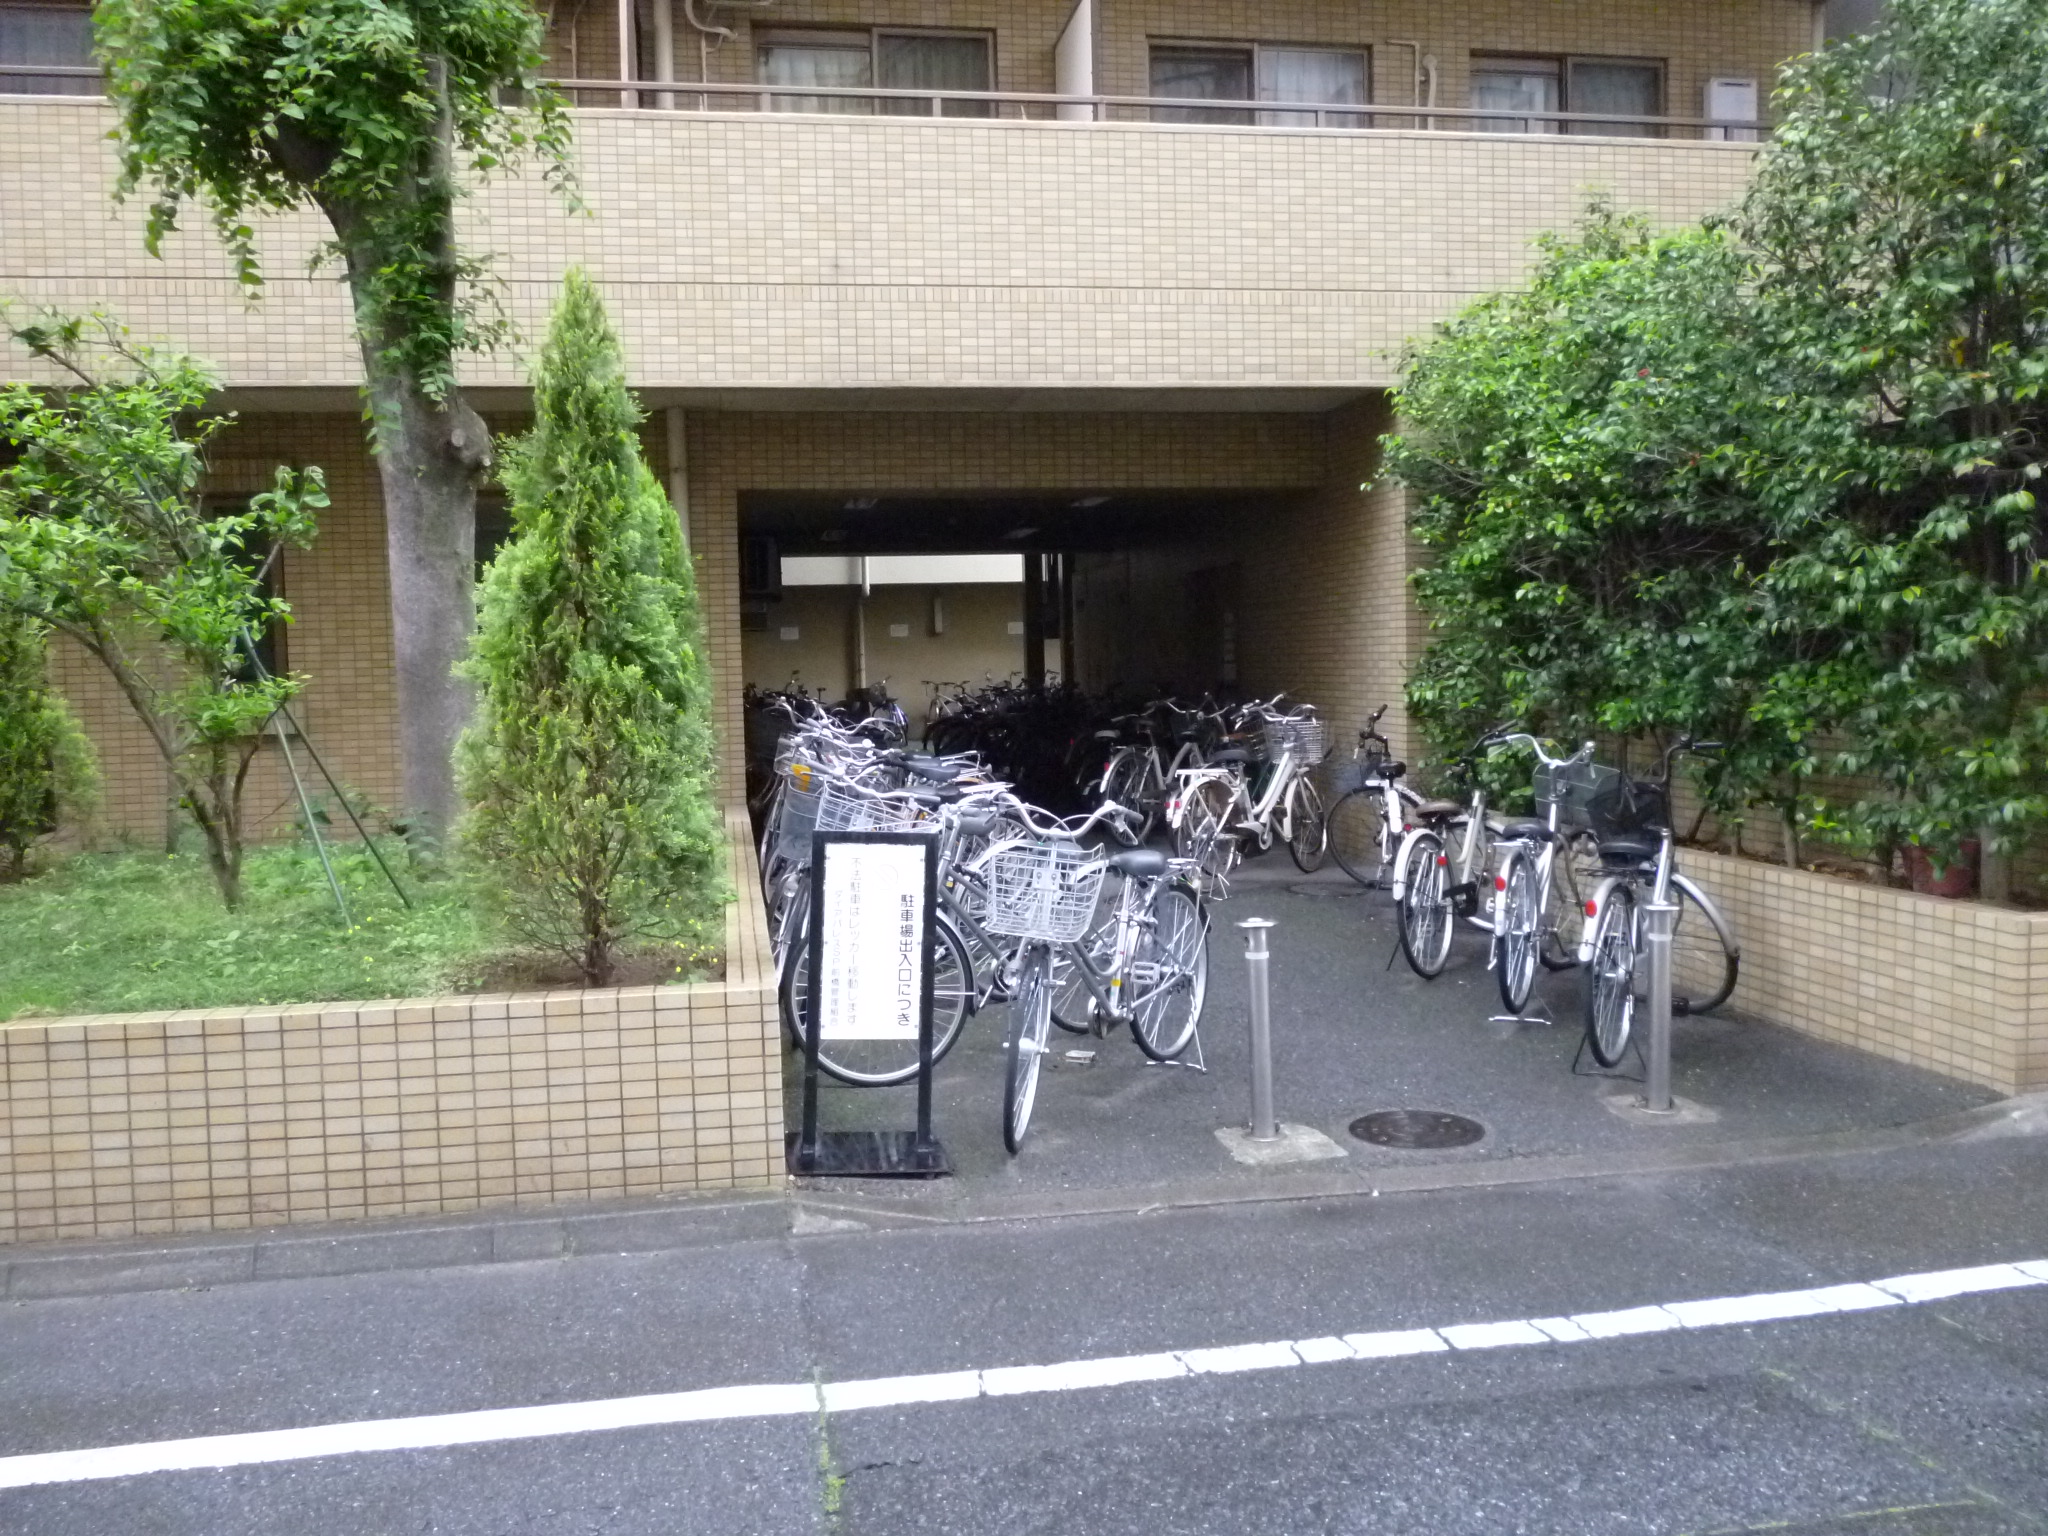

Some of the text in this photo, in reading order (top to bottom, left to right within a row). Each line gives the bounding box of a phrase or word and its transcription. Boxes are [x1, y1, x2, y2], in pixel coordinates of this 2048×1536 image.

[847, 857, 862, 1025] 不法駐車はレッカー移動します
[898, 894, 914, 1026] 駐車場出入口につき
